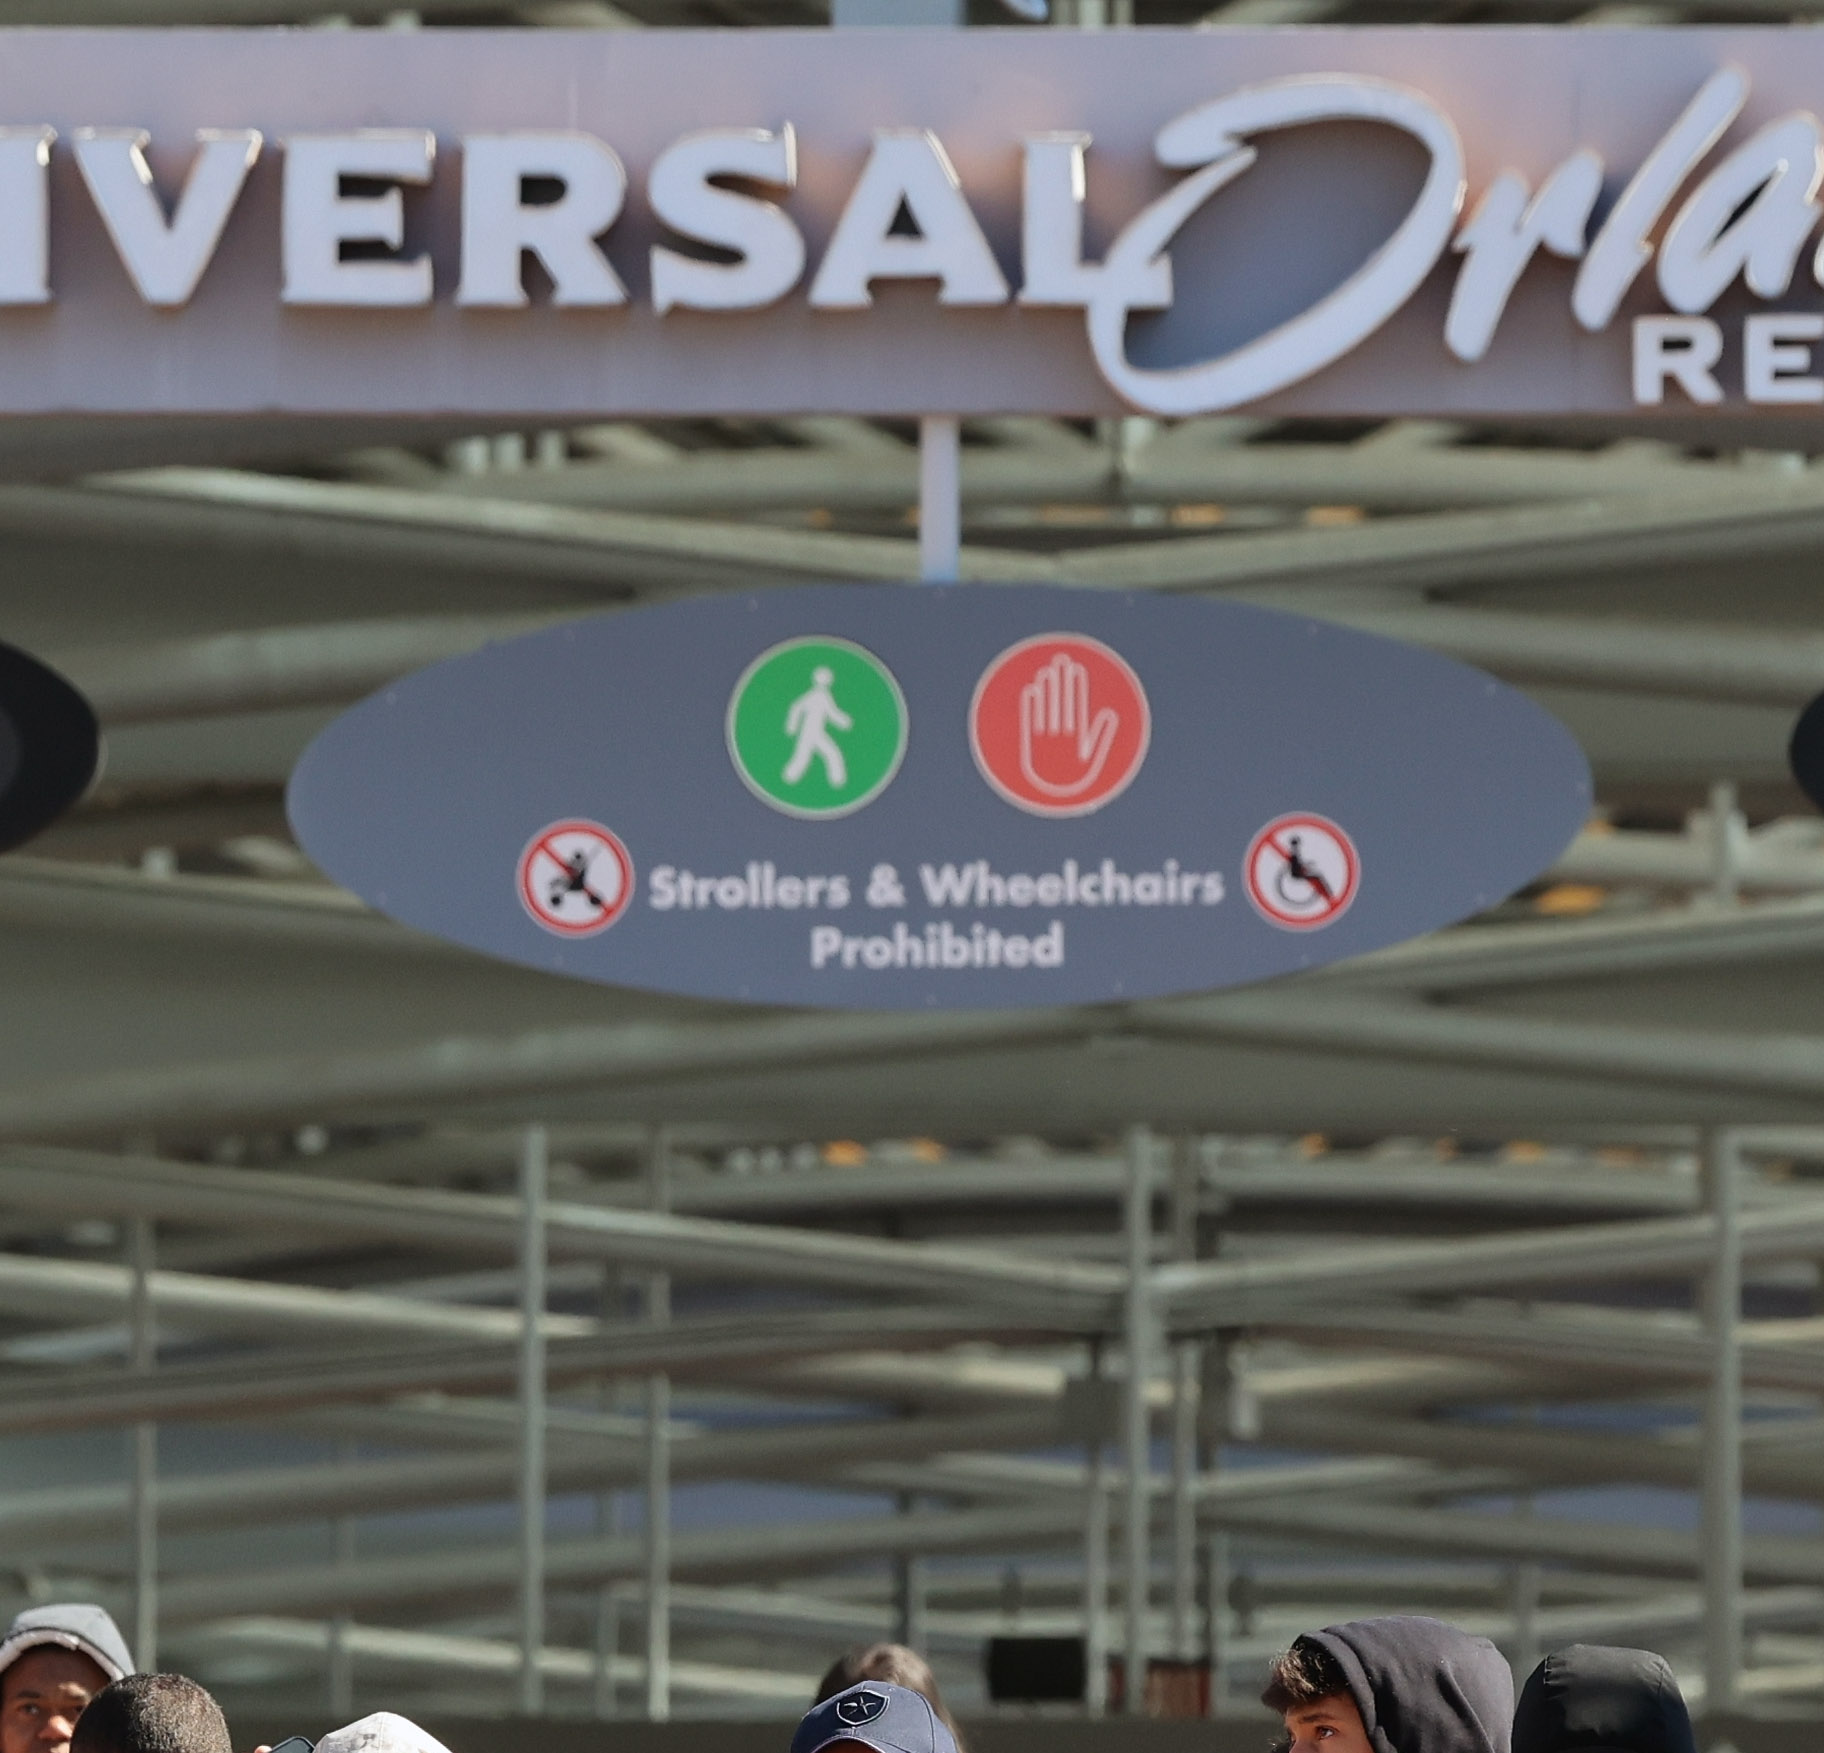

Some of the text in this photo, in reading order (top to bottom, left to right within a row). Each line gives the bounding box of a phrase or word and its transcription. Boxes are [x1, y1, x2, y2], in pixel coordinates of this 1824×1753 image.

[649, 857, 1225, 910] Strollers & Wheelchairs
[809, 919, 1065, 969] Prohibited
